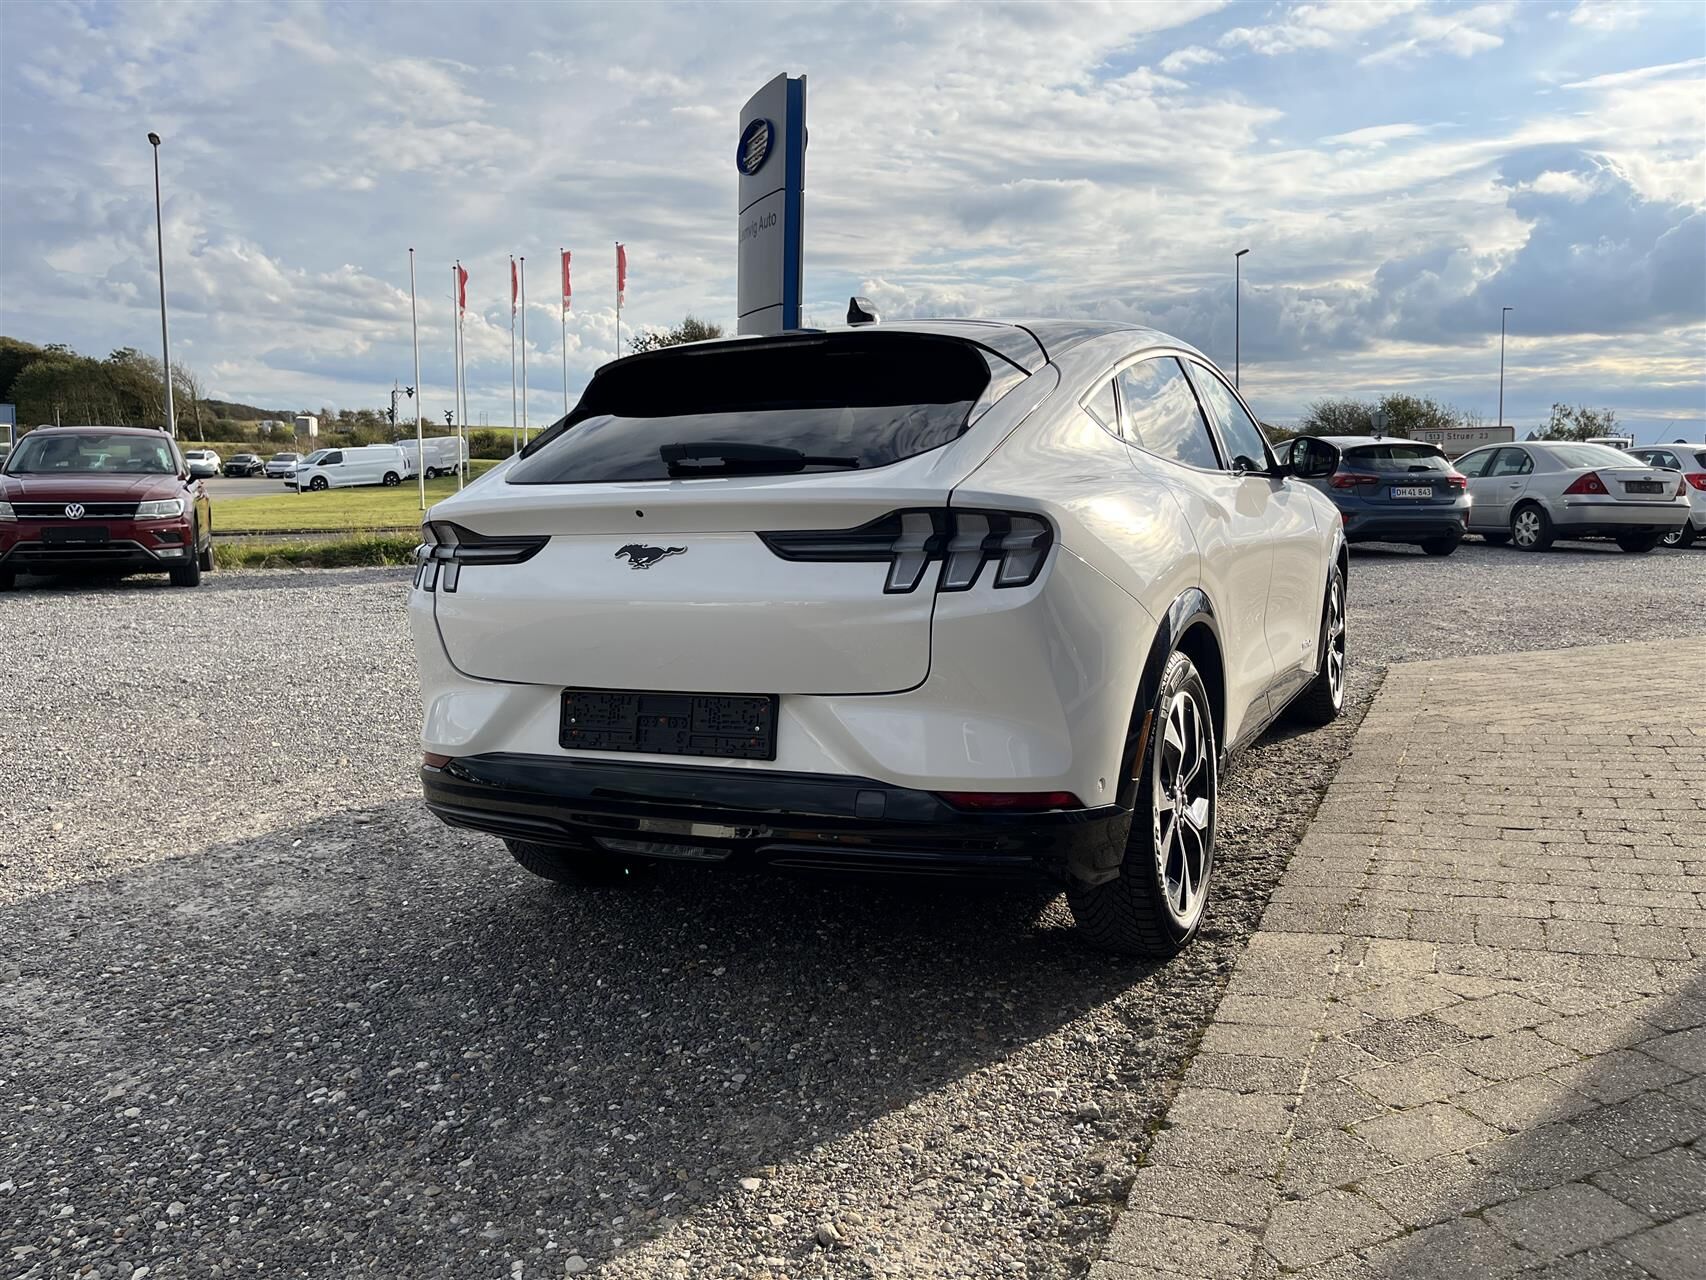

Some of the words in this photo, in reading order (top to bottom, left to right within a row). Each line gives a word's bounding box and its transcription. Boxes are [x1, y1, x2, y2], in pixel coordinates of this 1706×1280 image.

[759, 212, 777, 231] Auto
[1447, 432, 1474, 440] Struer
[1396, 488, 1407, 496] DH
[1408, 488, 1416, 496] 41
[1418, 488, 1431, 496] 843
